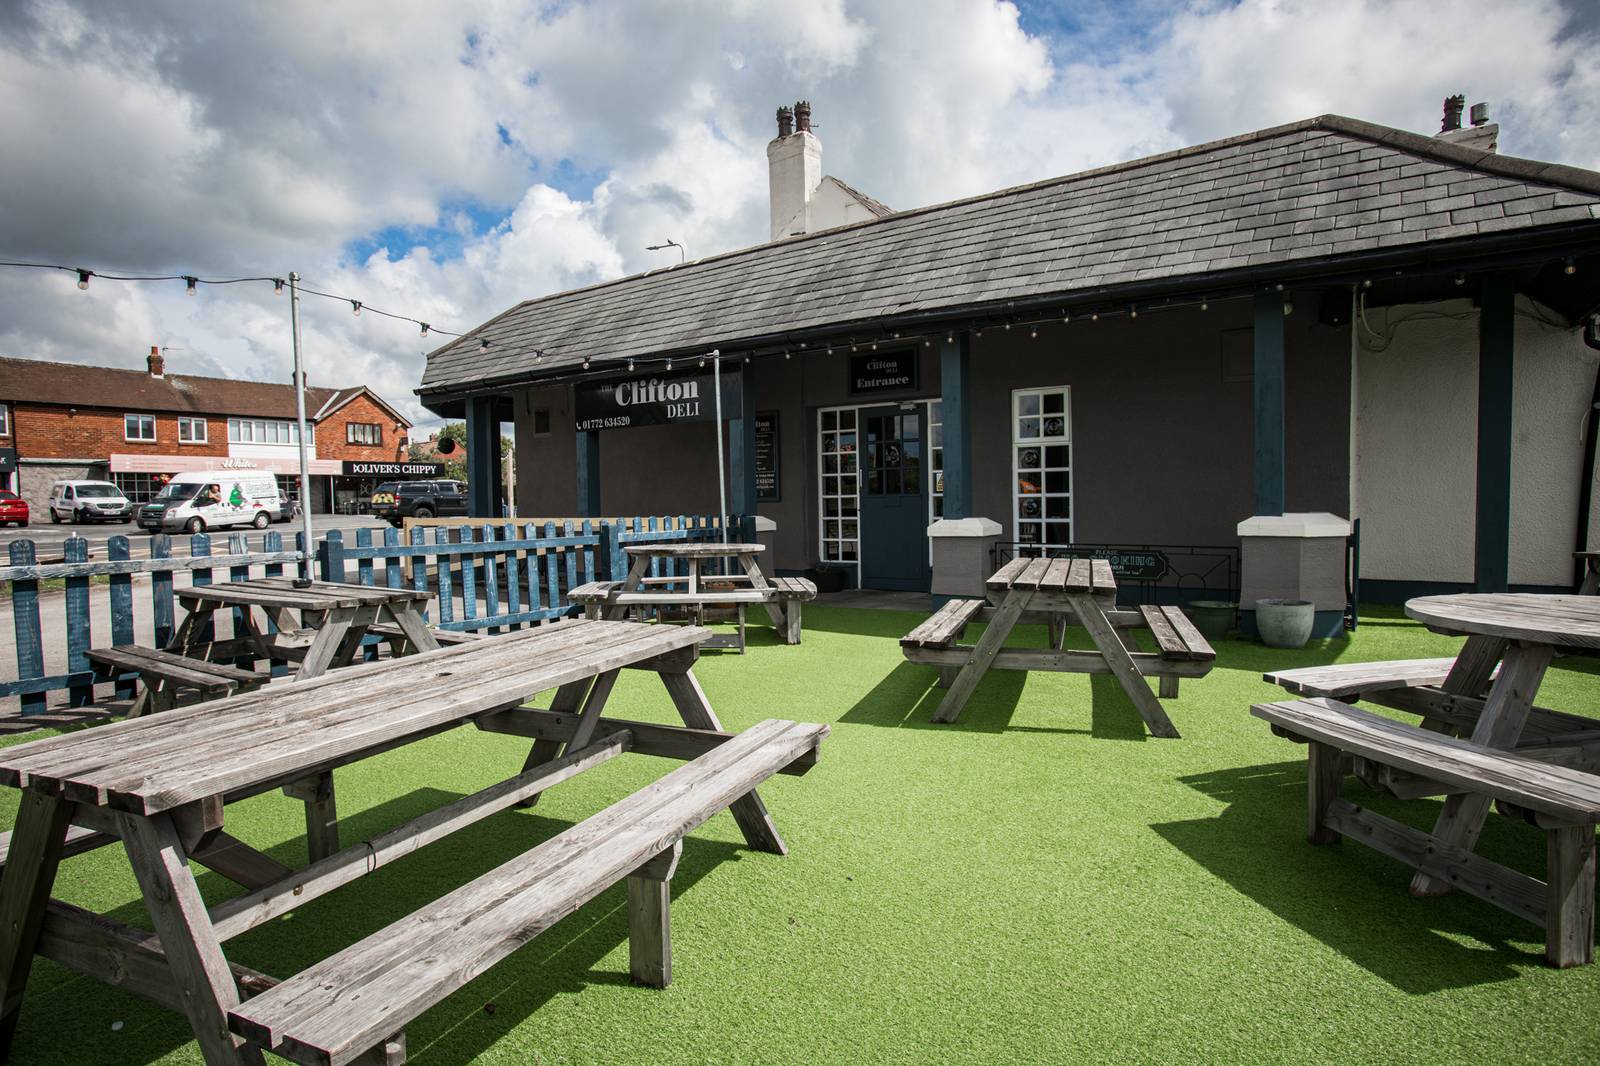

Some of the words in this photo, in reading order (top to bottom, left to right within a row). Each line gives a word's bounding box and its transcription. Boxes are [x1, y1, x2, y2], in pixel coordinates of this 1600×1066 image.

[866, 361, 898, 370] Clifton
[856, 377, 909, 388] Entrance
[615, 378, 700, 407] Clifton
[667, 402, 700, 419] DELI
[583, 419, 603, 430] 01772
[605, 416, 631, 428] 634520
[358, 464, 400, 474] OLIVER'S
[402, 465, 436, 474] CHIPPY
